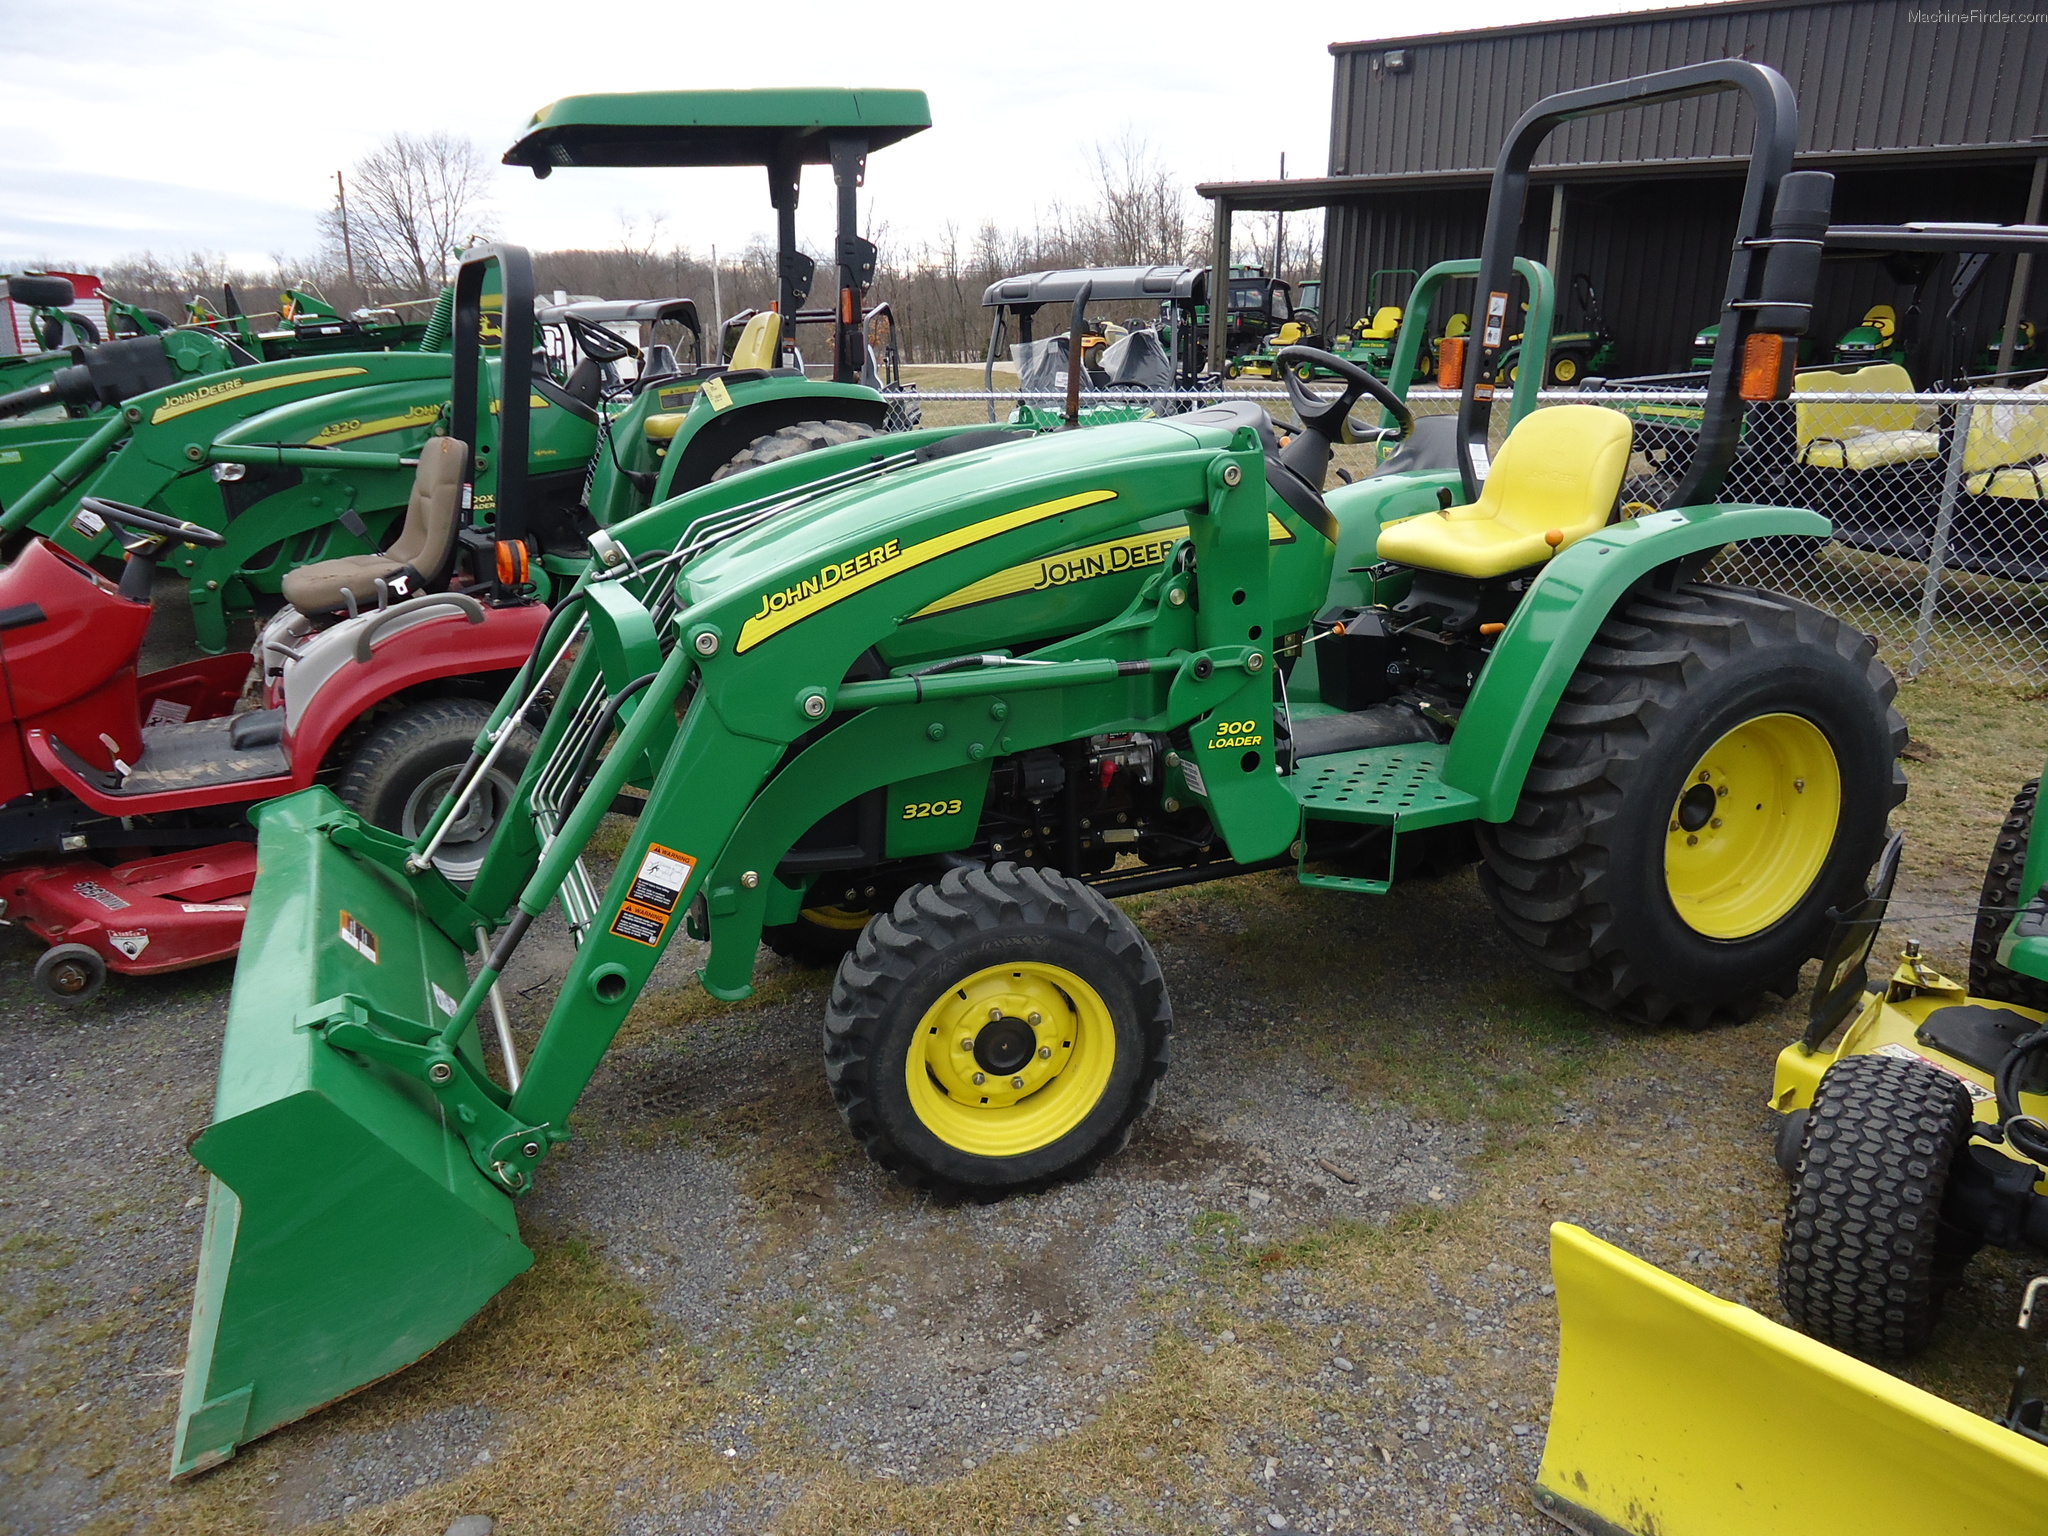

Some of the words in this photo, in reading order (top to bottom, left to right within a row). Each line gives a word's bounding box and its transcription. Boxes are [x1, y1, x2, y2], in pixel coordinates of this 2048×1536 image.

[162, 391, 198, 409] JOHN
[198, 378, 243, 399] DEERE
[320, 419, 361, 437] 4320
[473, 502, 497, 510] ADER
[1034, 553, 1107, 590] JOHN
[1109, 540, 1175, 573] DEER
[755, 576, 821, 620] JOHN
[820, 538, 903, 590] DEERE
[1216, 719, 1256, 736] 300
[1208, 735, 1262, 749] LOADER
[902, 799, 962, 819] 3203
[661, 849, 691, 864] WARNING
[634, 907, 663, 921] WARNING
